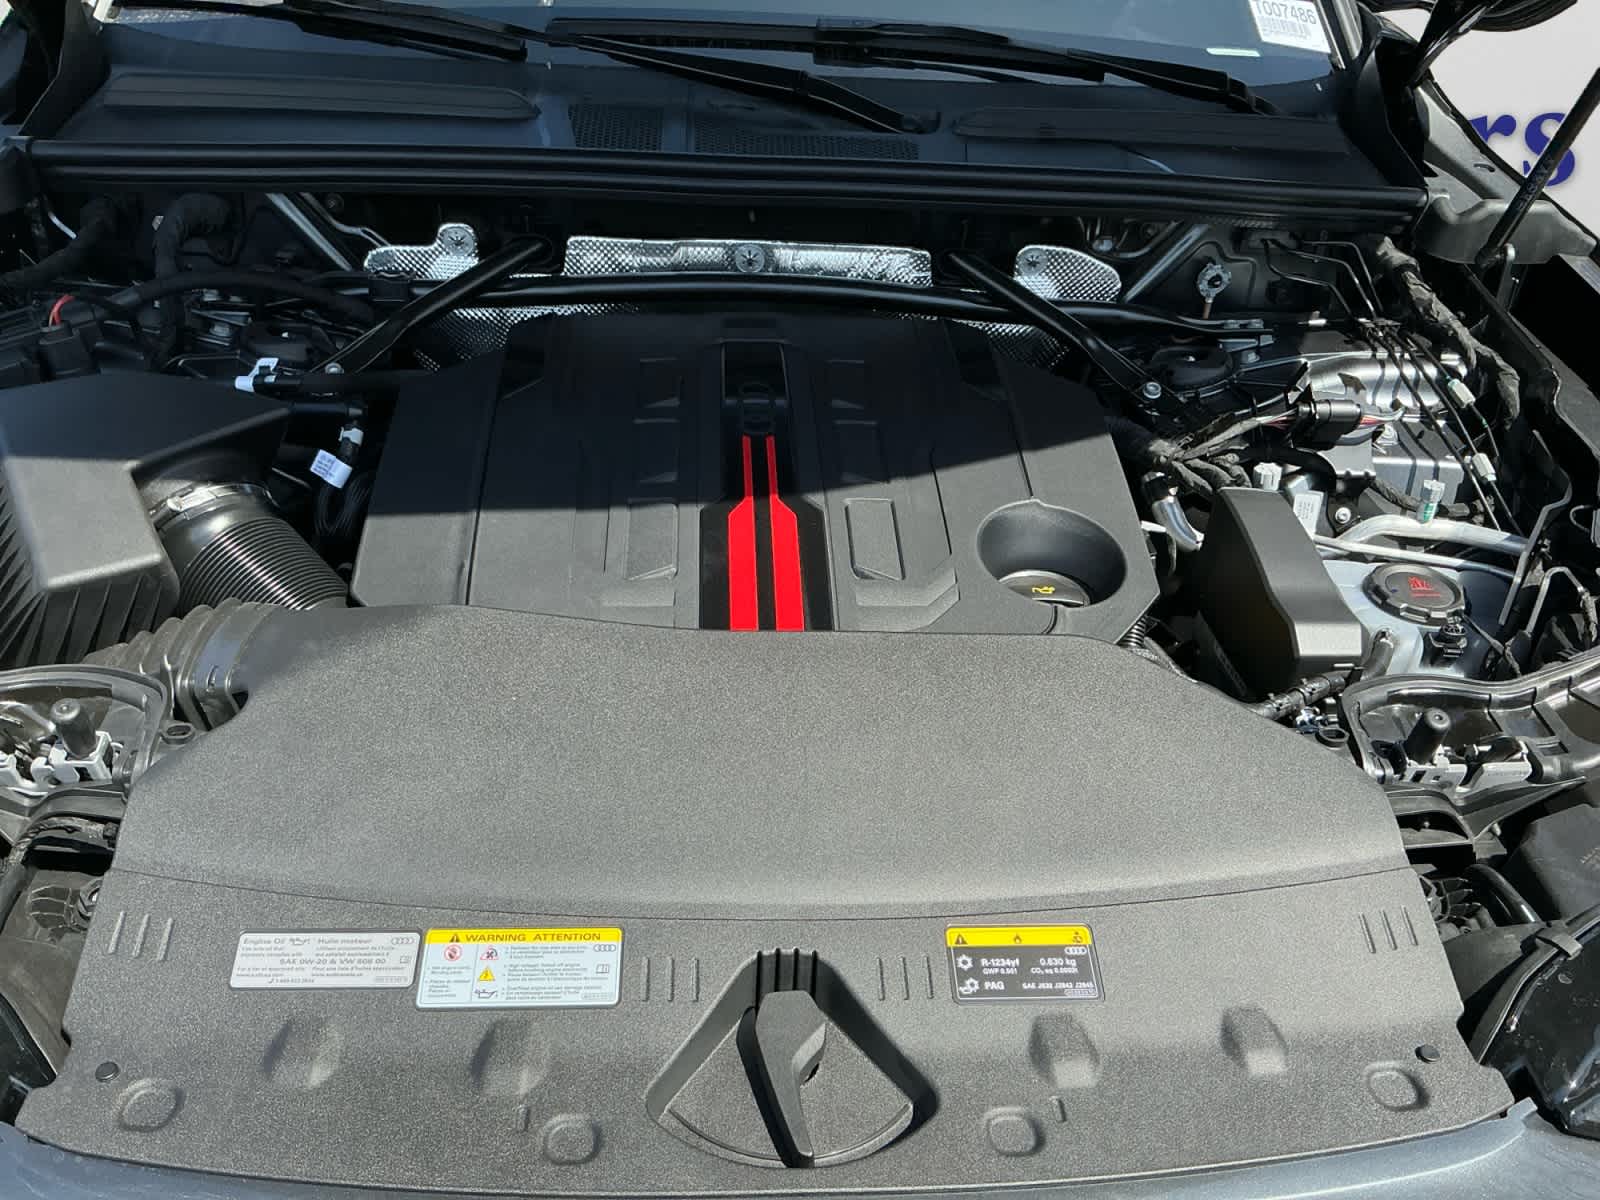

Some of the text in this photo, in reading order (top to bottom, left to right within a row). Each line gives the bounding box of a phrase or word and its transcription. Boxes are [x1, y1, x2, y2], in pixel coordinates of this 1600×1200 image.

[465, 933, 601, 942] WARNING ATTENTION
[1065, 957, 1077, 967] kg
[984, 980, 1005, 990] PAG
